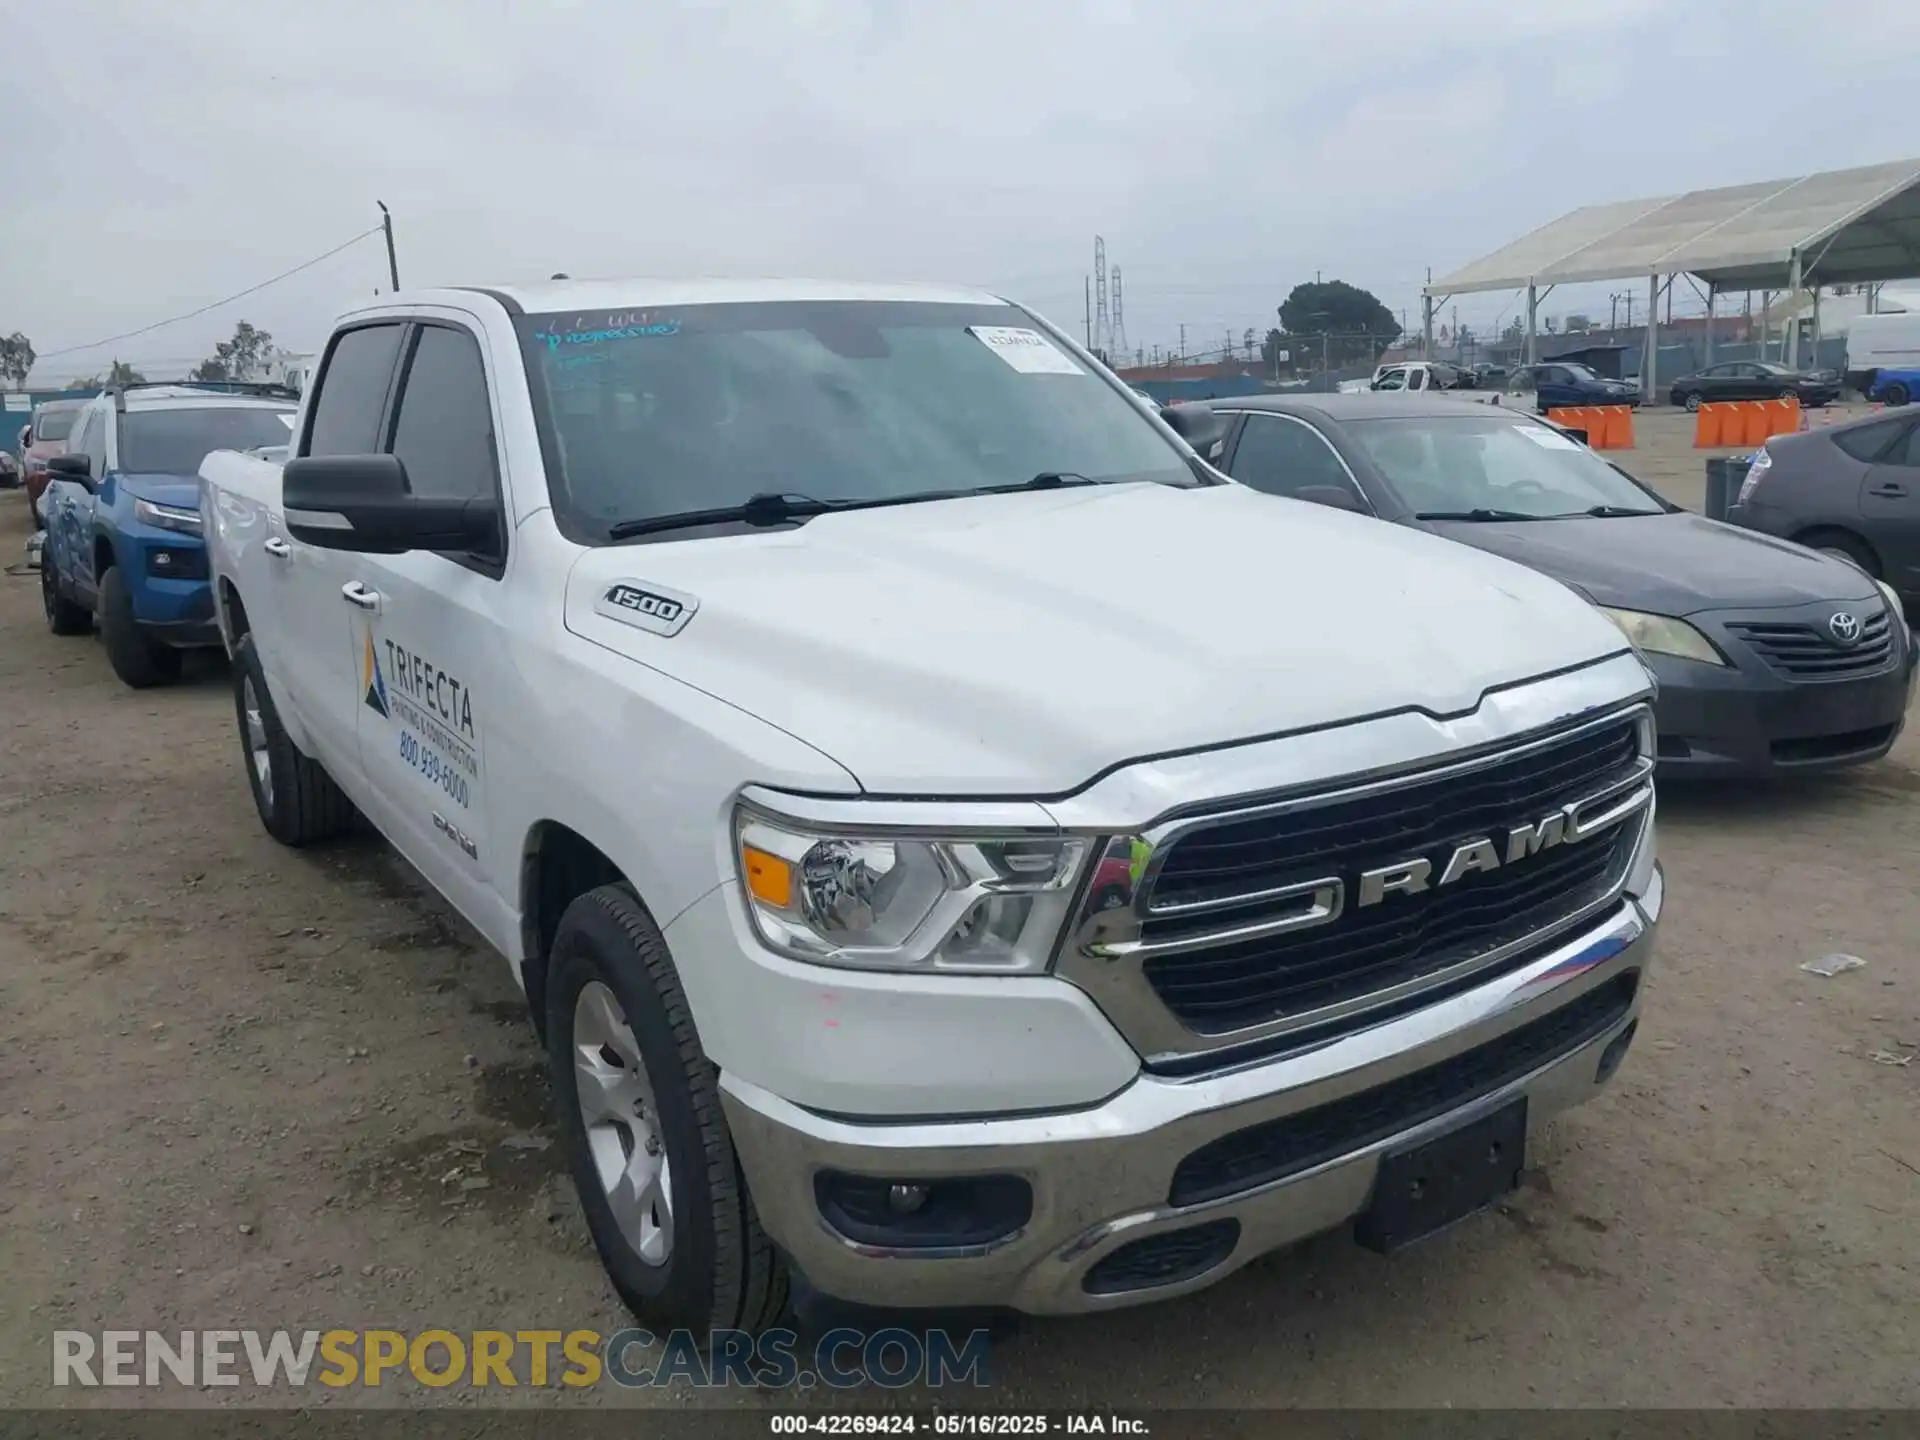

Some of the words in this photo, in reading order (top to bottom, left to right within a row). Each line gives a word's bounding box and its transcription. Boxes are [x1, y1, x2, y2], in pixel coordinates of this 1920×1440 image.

[614, 588, 682, 621] 1500
[385, 639, 474, 739] TRIFECTA
[400, 731, 418, 767] 800
[421, 746, 468, 808] 939-6000
[1358, 812, 1565, 908] RAM
